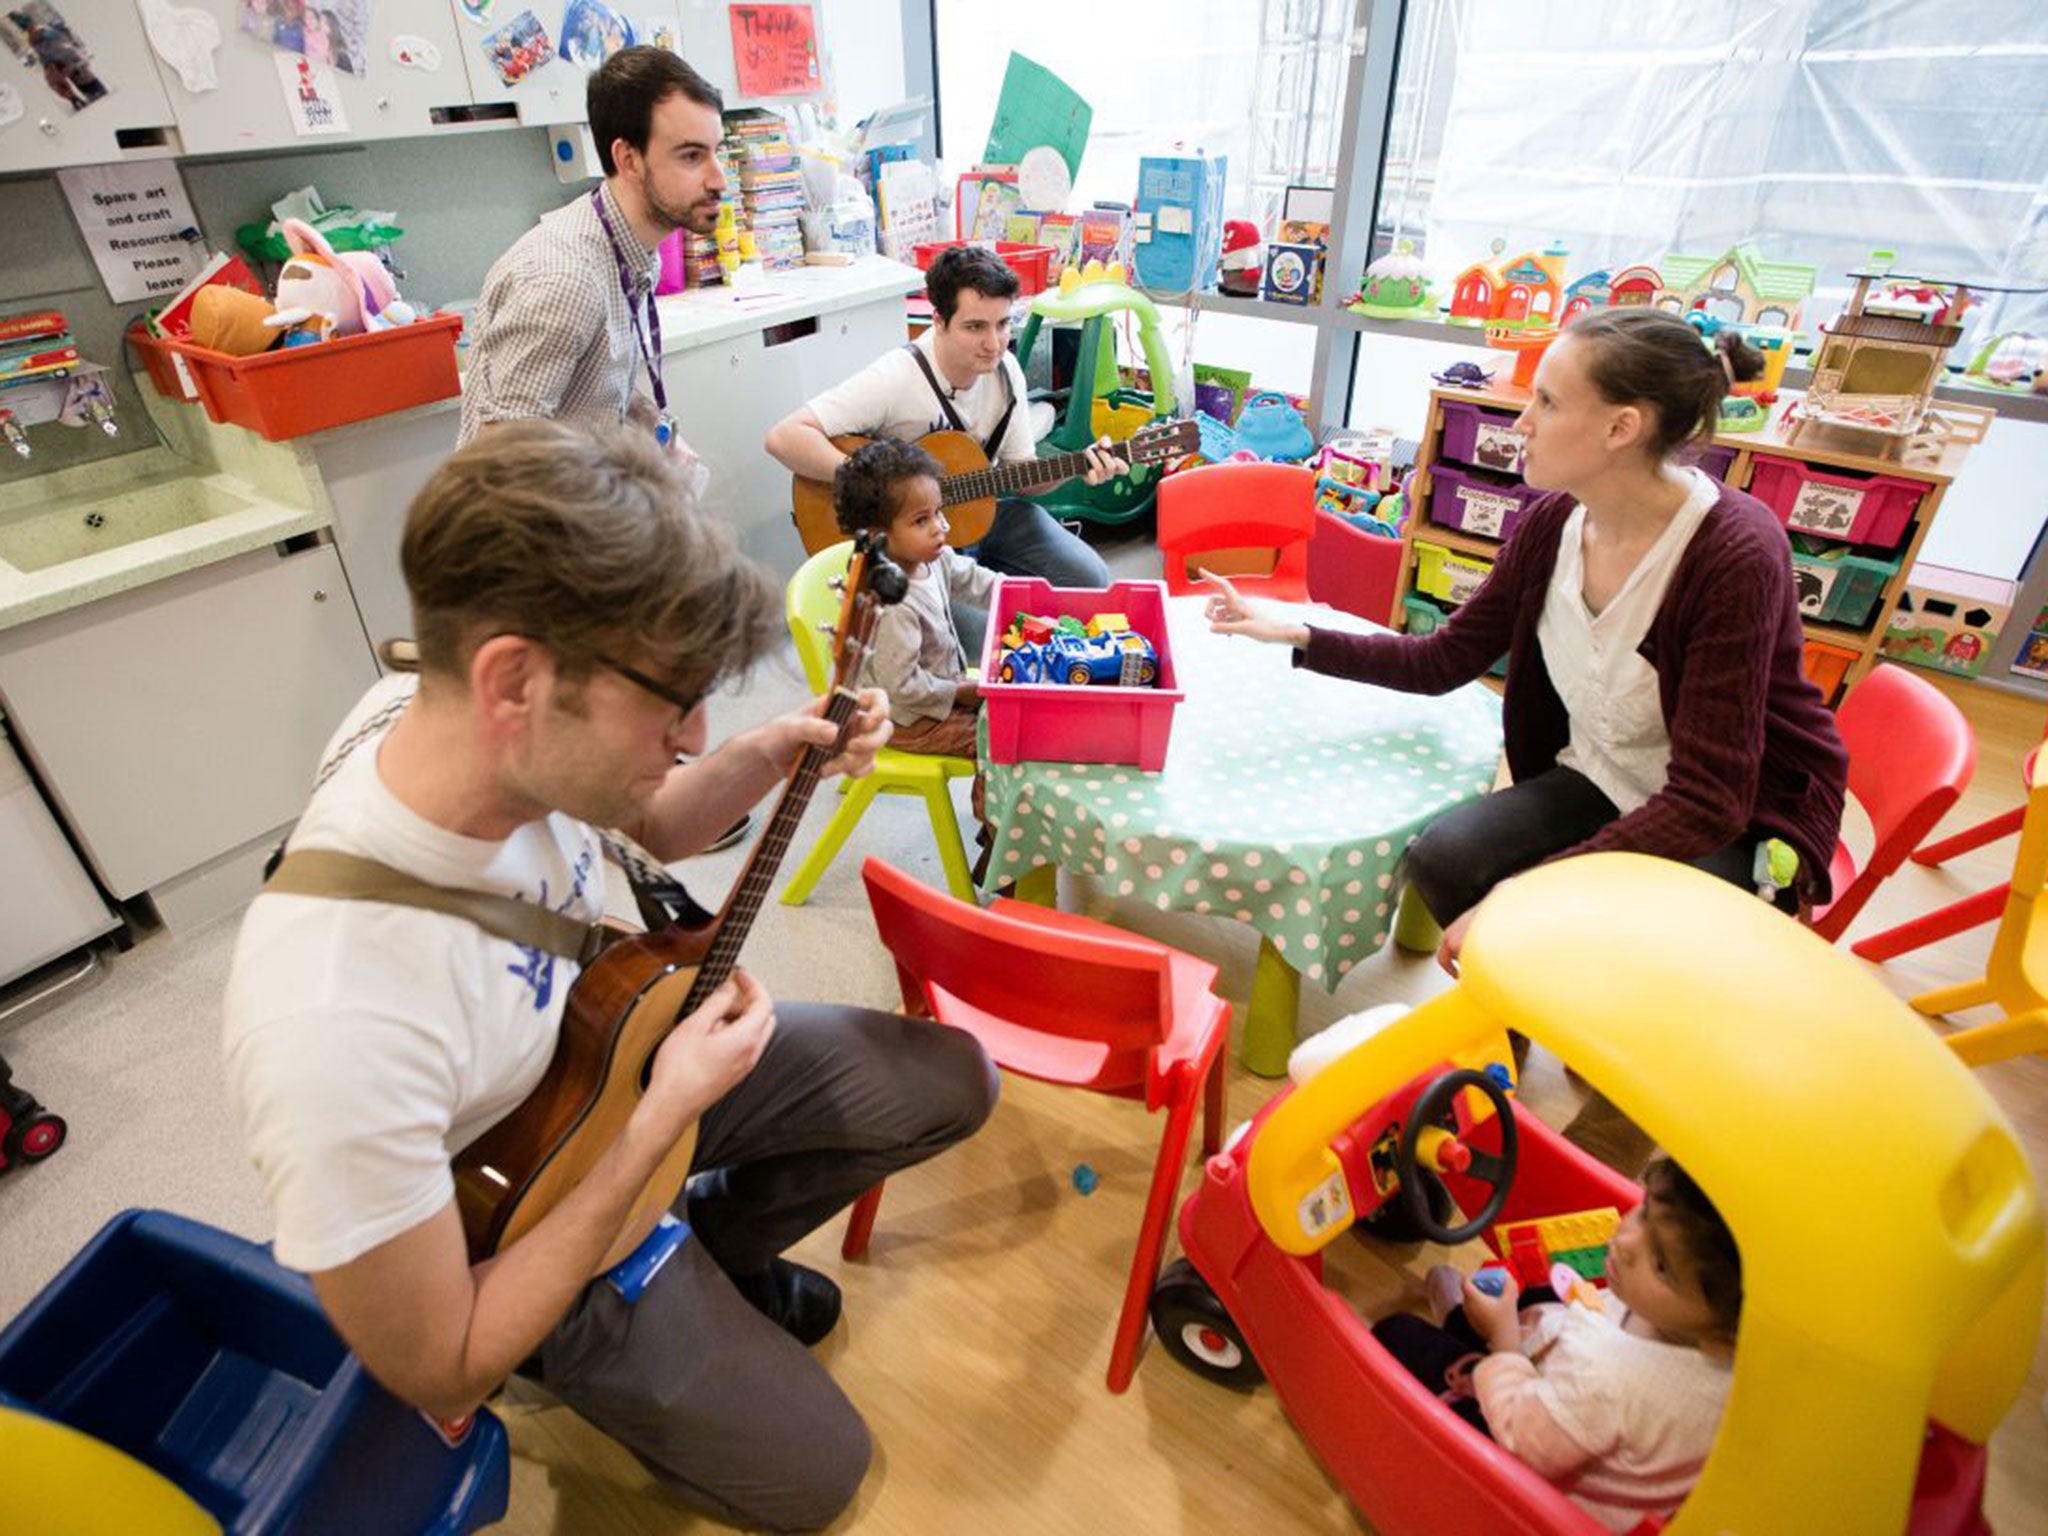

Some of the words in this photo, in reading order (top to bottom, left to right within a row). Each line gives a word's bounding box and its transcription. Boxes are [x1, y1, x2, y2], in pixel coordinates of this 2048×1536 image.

[92, 192, 137, 206] Spare
[145, 187, 166, 199] art
[106, 213, 133, 226] and
[137, 208, 172, 222] craft
[132, 256, 181, 271] Please
[145, 277, 184, 291] leave
